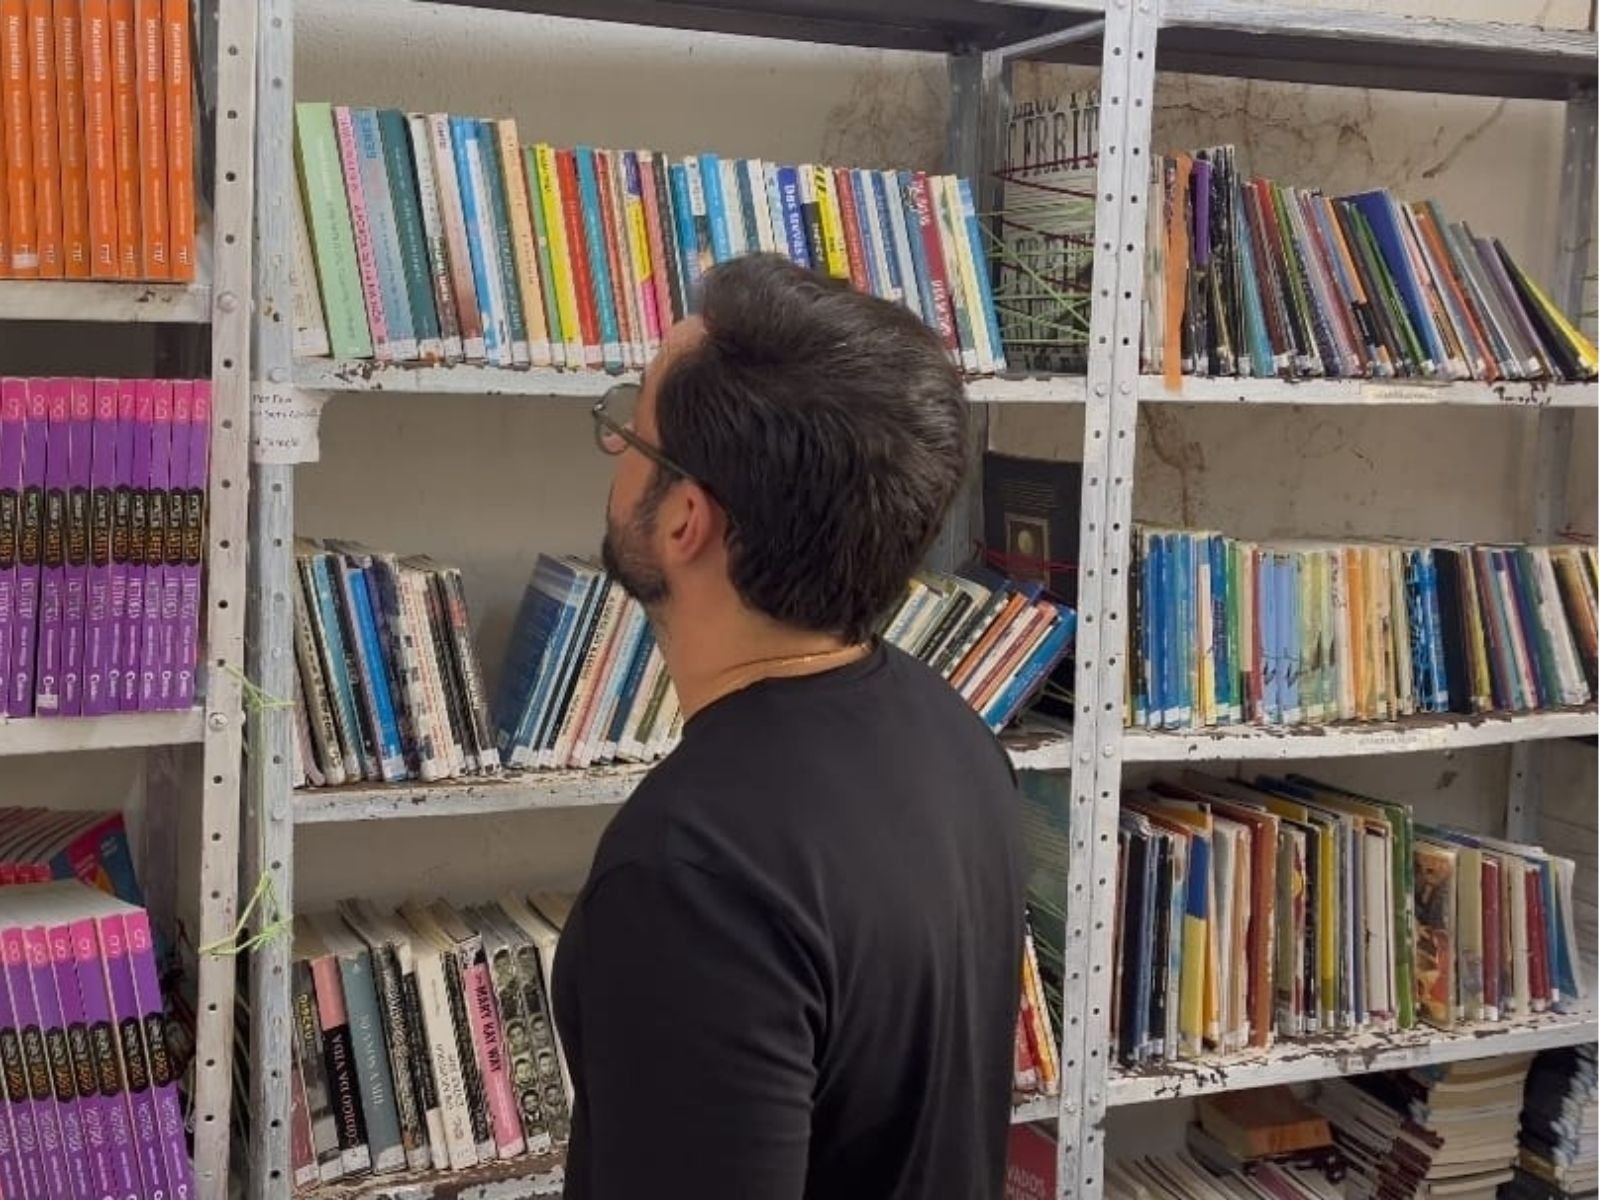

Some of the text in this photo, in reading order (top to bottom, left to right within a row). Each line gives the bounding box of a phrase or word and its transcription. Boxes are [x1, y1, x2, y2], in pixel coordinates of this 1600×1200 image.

[33, 395, 45, 416] 8
[100, 397, 112, 417] 8
[122, 395, 133, 415] 7
[10, 941, 20, 961] 8
[474, 986, 491, 1019] MARY
[483, 1022, 496, 1044] KAY
[487, 1047, 501, 1072] WAY
